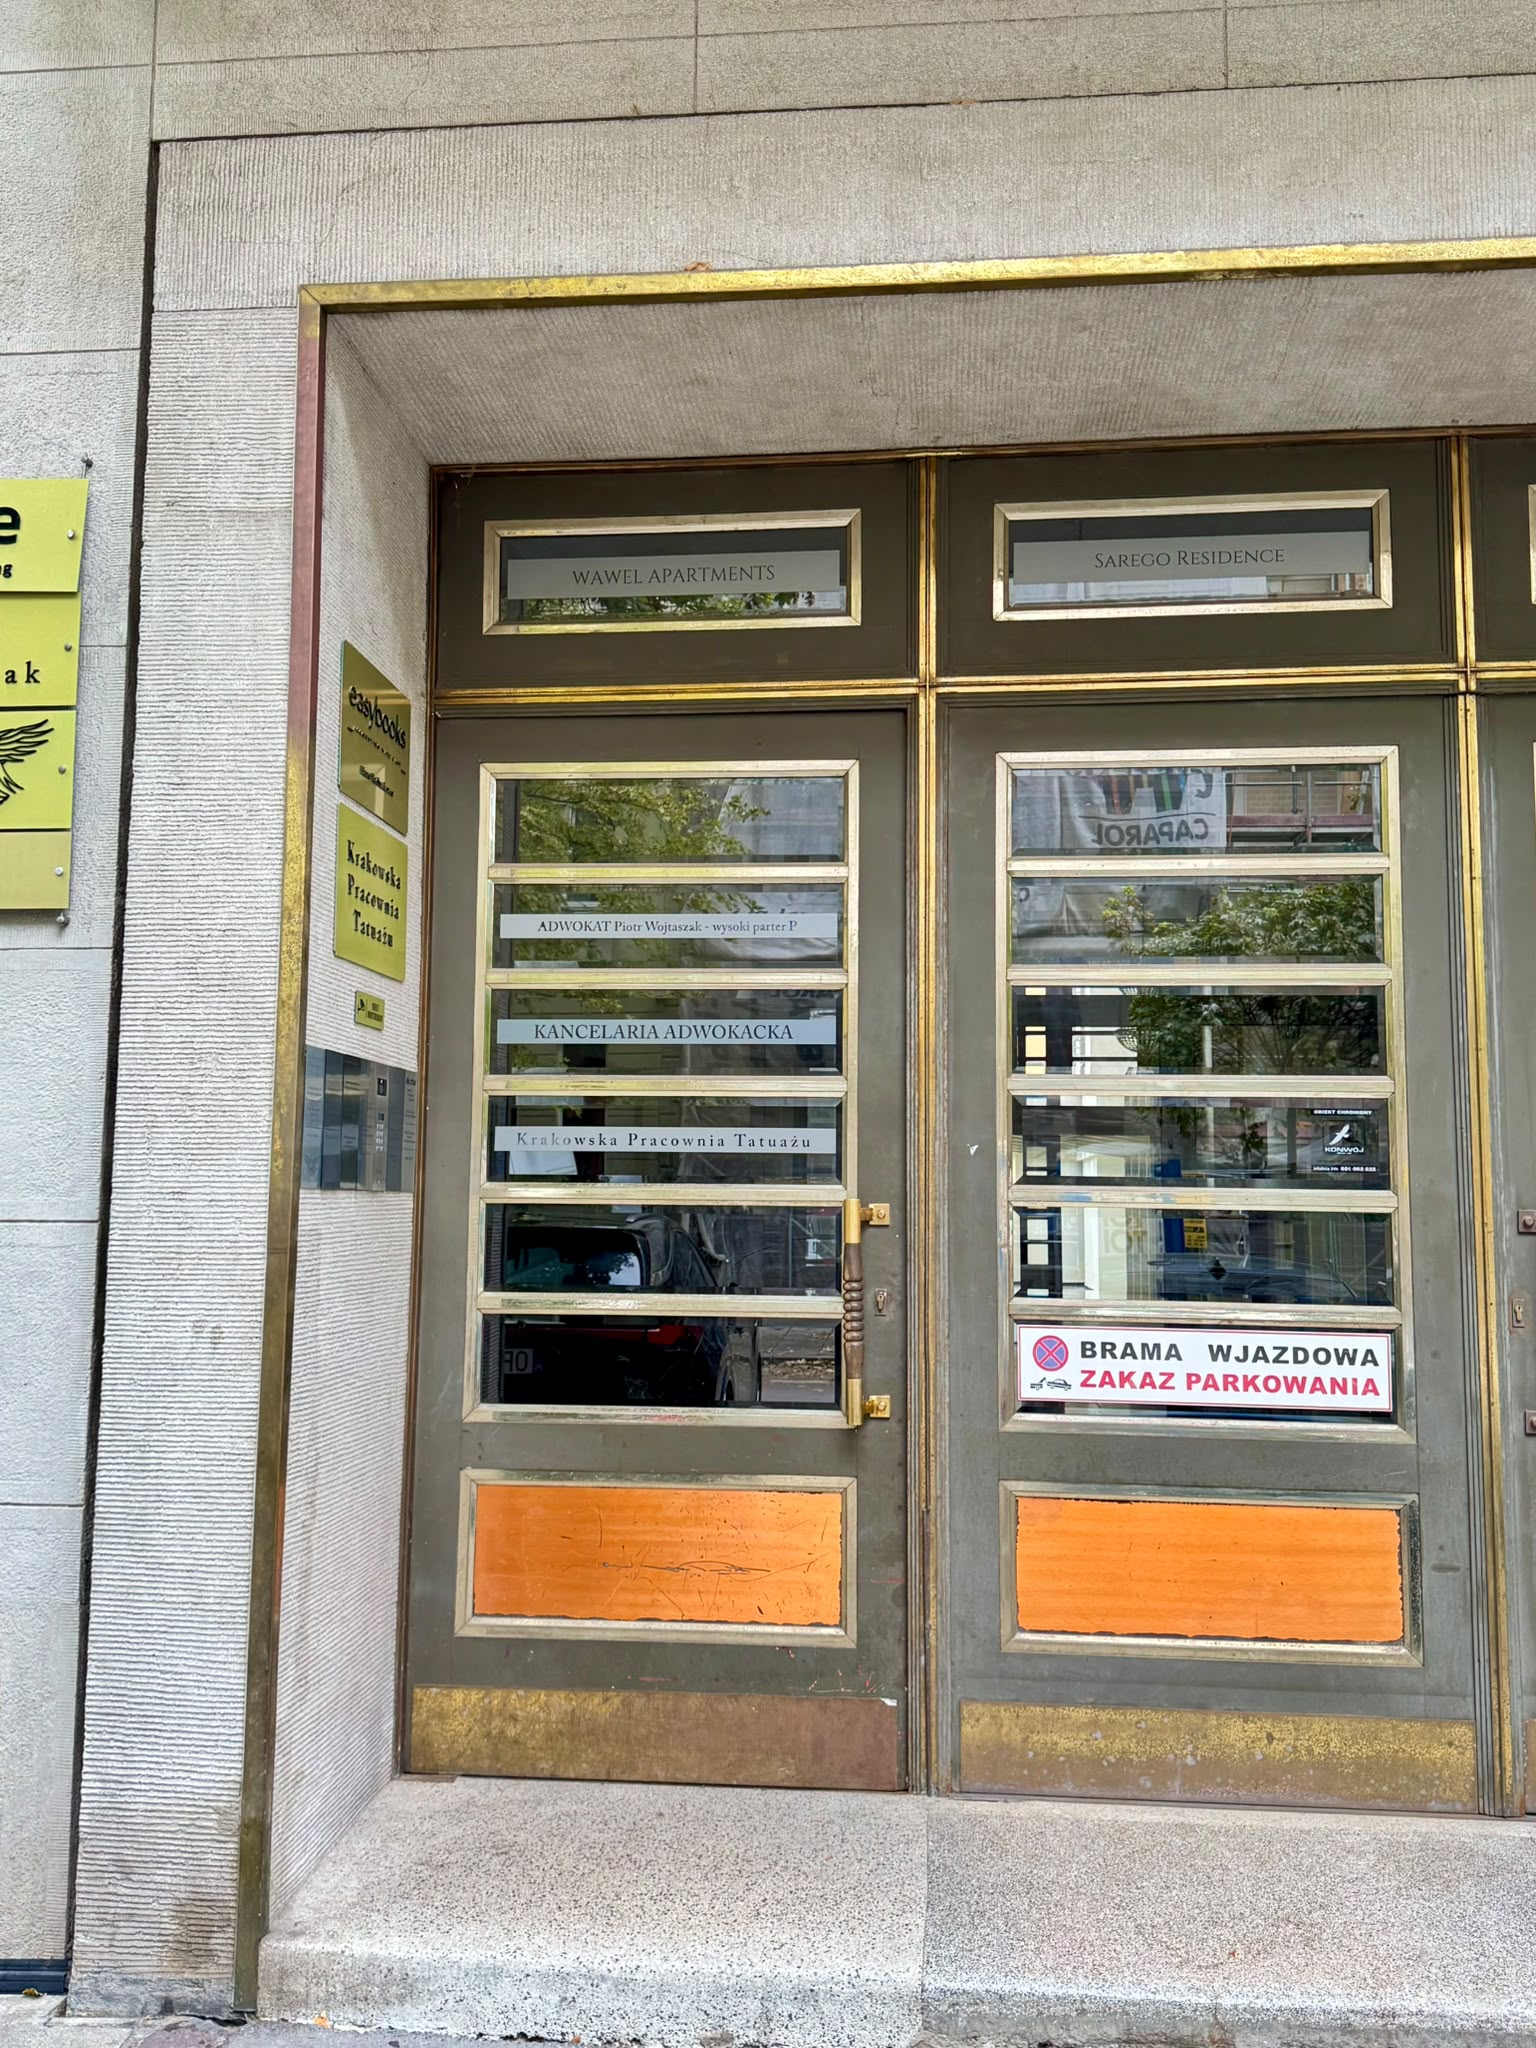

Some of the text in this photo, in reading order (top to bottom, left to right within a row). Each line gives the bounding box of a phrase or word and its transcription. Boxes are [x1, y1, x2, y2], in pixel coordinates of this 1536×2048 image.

[572, 565, 775, 585] WAWEL APARTMENTS
[347, 686, 406, 749] easybooks
[347, 840, 401, 890] Krakowska
[347, 873, 399, 920] Pracownia
[538, 920, 612, 932] ADWOKAT
[614, 920, 643, 932] Piotr
[645, 920, 702, 935] Wojtaszak
[712, 920, 750, 935] wysoki
[753, 923, 787, 935] parter
[788, 920, 798, 932] P
[534, 1023, 794, 1040] KANCELARIA ADWOKACKA
[516, 1132, 811, 1148] Krakowska Pracownia Tatuażu
[1080, 1341, 1380, 1367] BRAMA WJAZDOWA
[1080, 1369, 1381, 1397] ZAKAZ PARKOWANIA
